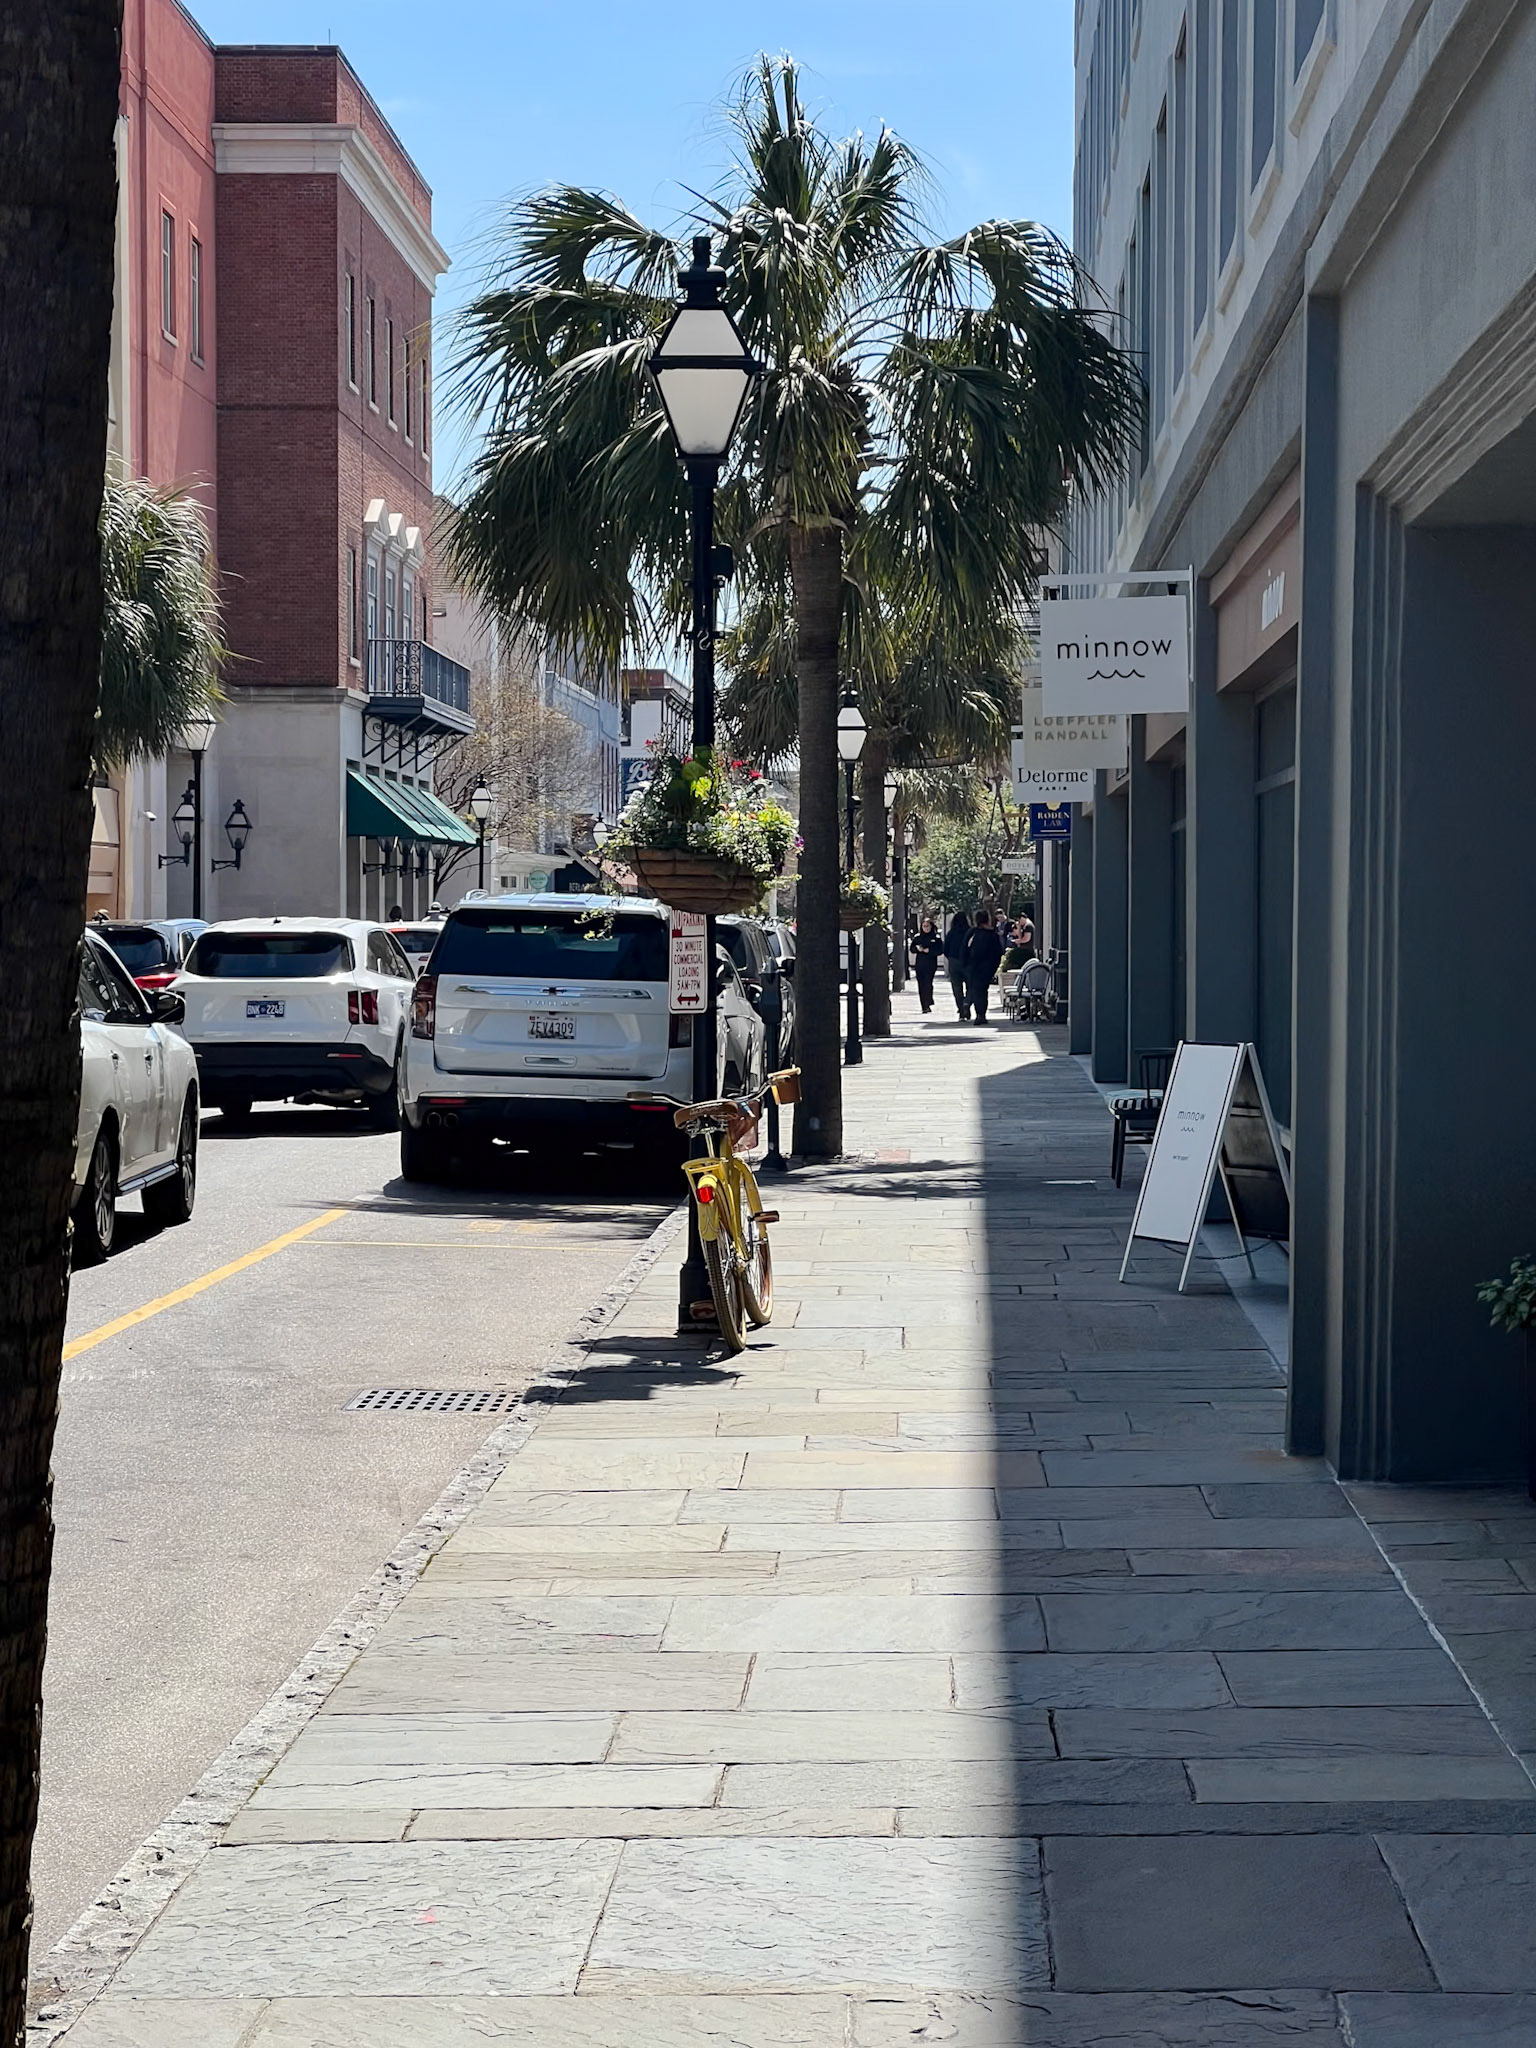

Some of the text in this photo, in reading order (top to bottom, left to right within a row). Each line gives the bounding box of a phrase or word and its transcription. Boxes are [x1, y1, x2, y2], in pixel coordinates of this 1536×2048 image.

[1057, 634, 1172, 660] minnow
[1034, 715, 1117, 727] LOEFFLER
[1034, 729, 1108, 741] RANDALL
[1017, 768, 1089, 784] Delorme
[672, 910, 682, 930] NO
[676, 941, 702, 952] 30 MINUTE
[674, 953, 703, 964] COMMERCIAL
[678, 966, 699, 977] LOADING
[1178, 1111, 1205, 1121] minnow
